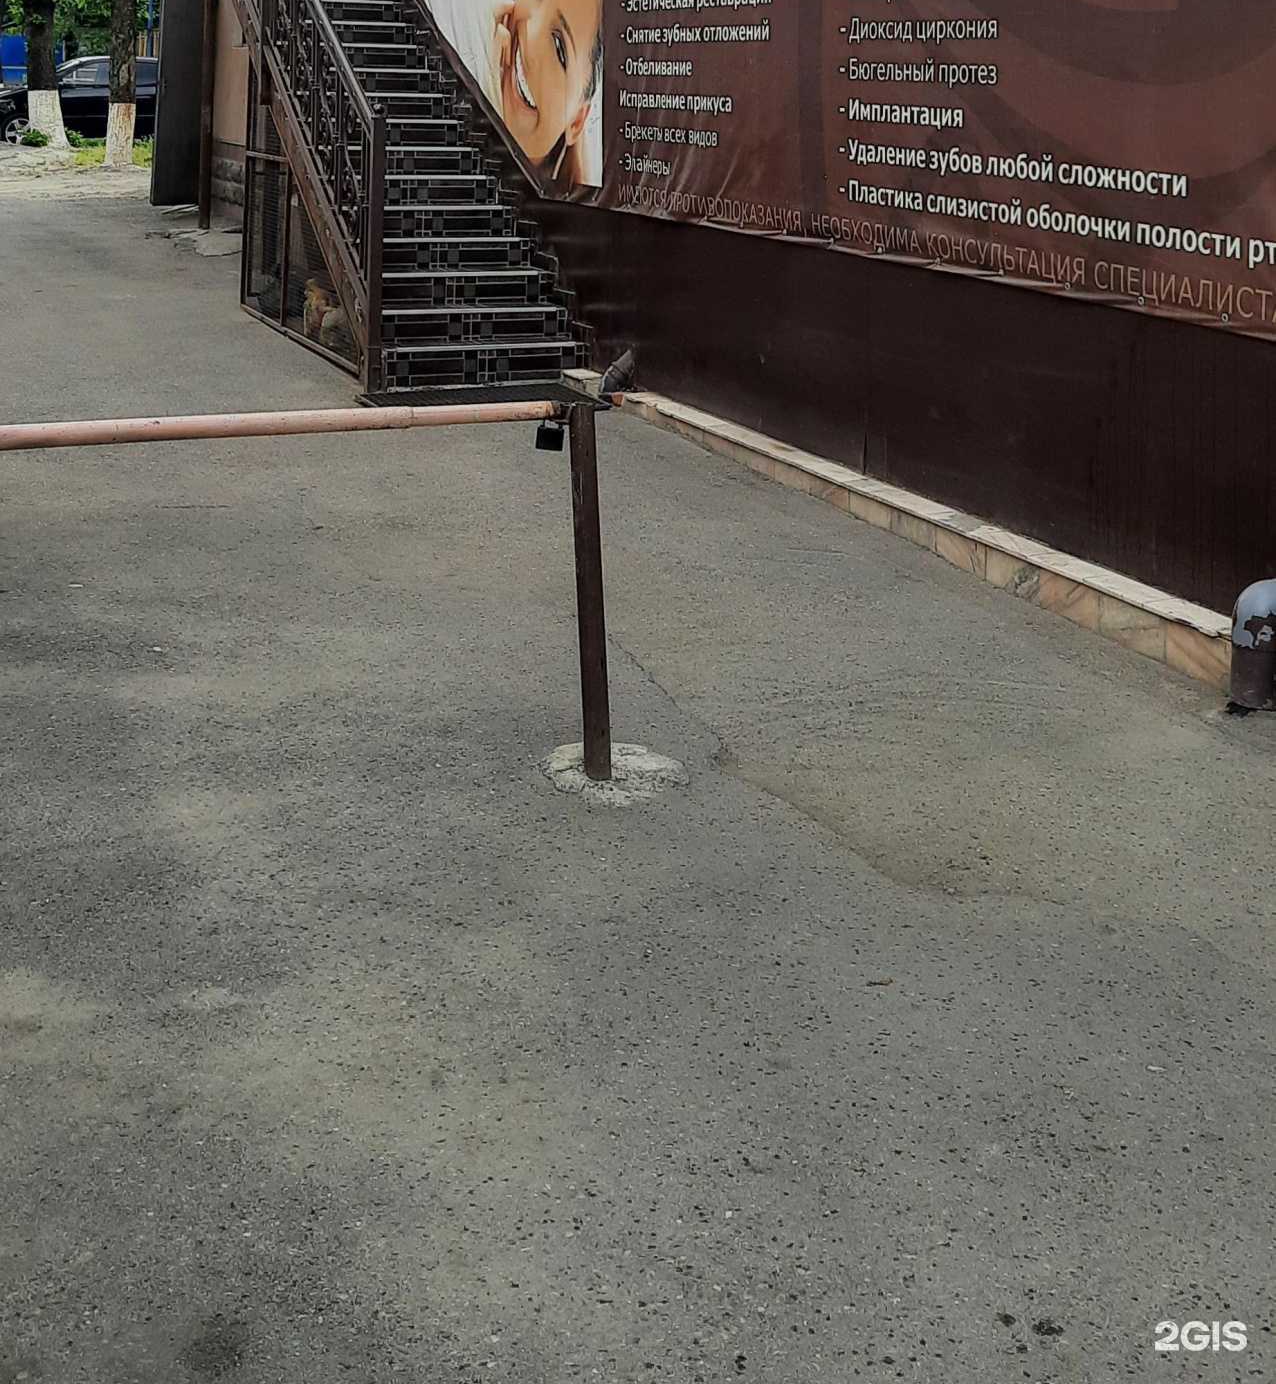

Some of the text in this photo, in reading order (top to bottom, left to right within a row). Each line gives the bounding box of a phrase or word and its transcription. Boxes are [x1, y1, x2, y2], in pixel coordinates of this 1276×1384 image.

[626, 25, 661, 44] Снятие
[662, 23, 701, 46] зубных
[703, 20, 769, 42] отложений
[849, 17, 912, 44] Диоксид
[917, 19, 998, 44] циркония
[626, 58, 692, 76] Отбеливание
[849, 58, 935, 82] Бюгельный
[939, 64, 997, 88] протез
[620, 90, 732, 115] Исправление прикуса
[849, 99, 964, 130] Имплантация
[625, 122, 663, 141] Брекеты
[664, 127, 685, 144] всех
[689, 130, 717, 148] видов
[625, 153, 670, 176] Элайнеры
[848, 139, 926, 167] Удаление
[929, 147, 982, 176] зубов
[986, 153, 1054, 182] любой
[1058, 163, 1188, 197] сложности
[849, 180, 923, 211] Пластика
[926, 198, 1022, 226] слизистой
[1026, 204, 1131, 243] оболочки
[1136, 222, 1241, 259] полости
[812, 213, 922, 254] НЕОБХОДИМА
[927, 231, 1085, 286] КОНСУЛЬТАЦИЯ
[1095, 261, 1276, 323] СПЕЦИАЛИСТ
